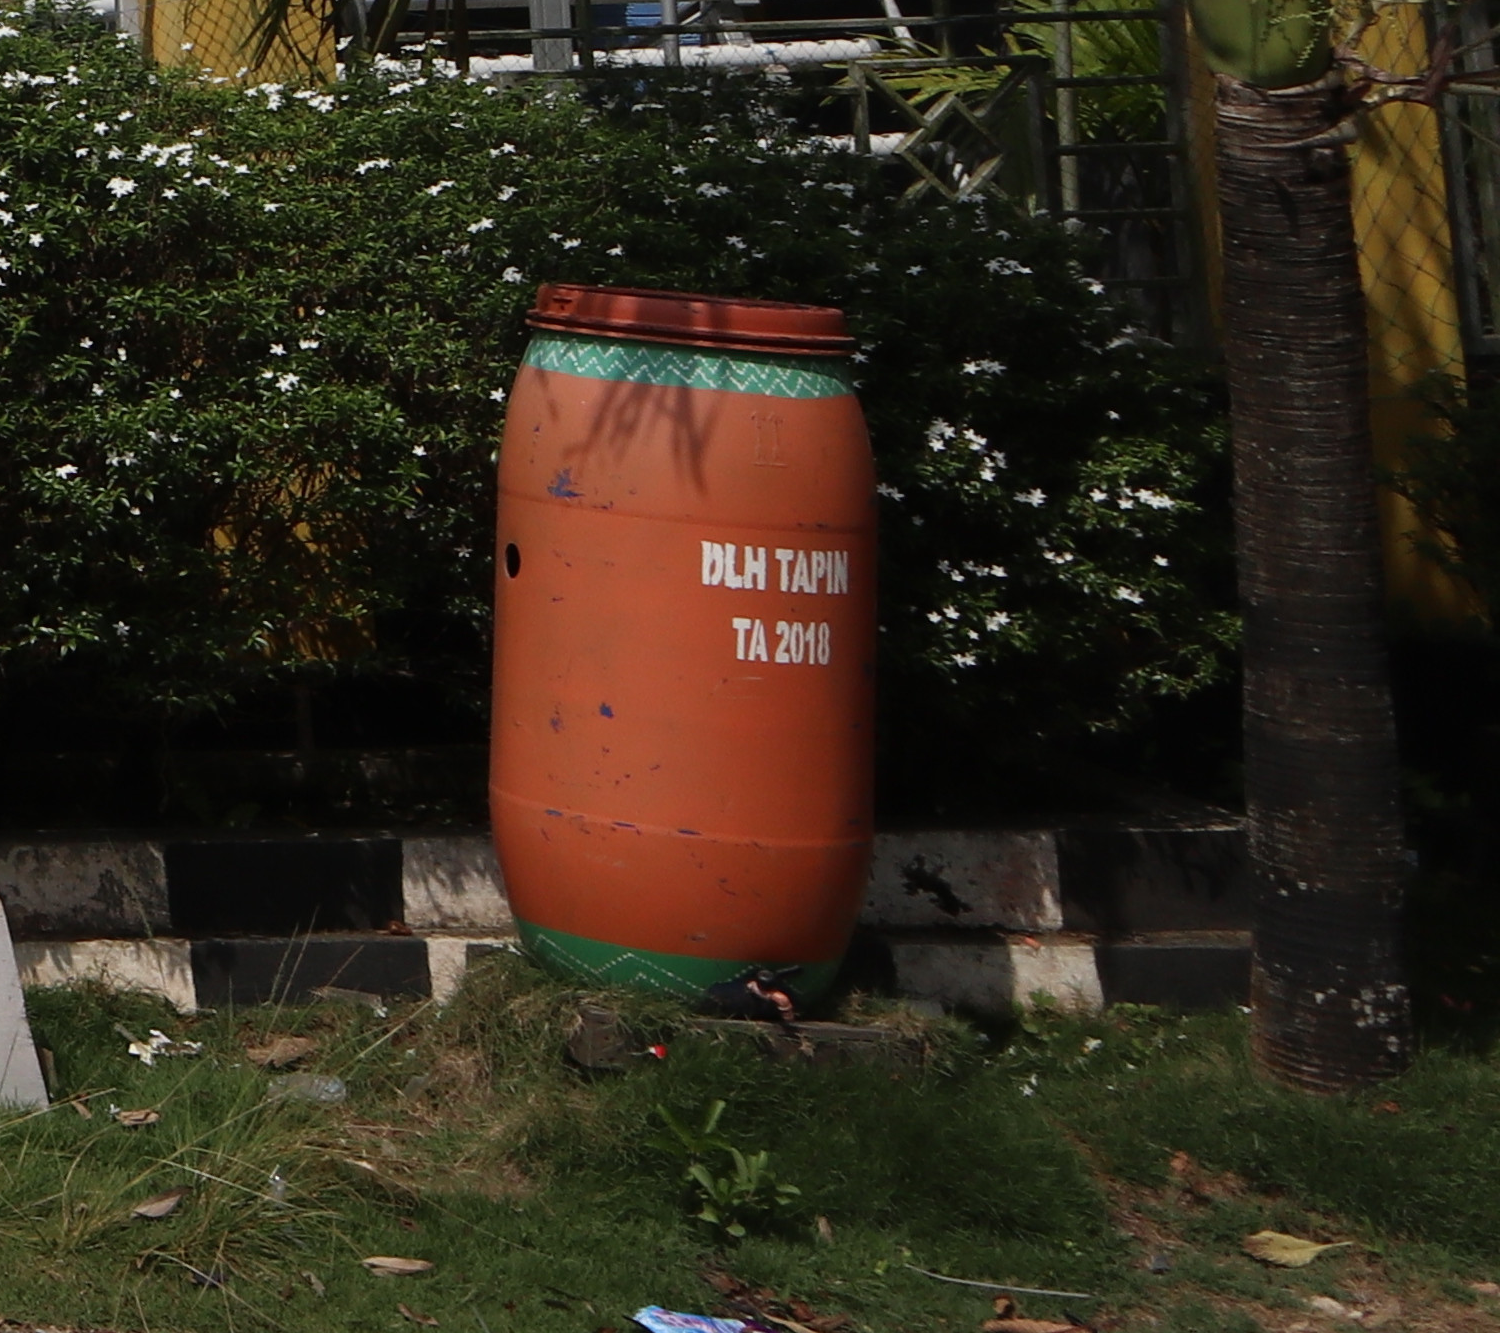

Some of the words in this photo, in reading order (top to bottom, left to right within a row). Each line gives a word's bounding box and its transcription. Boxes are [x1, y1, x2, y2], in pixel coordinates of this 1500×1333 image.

[701, 540, 767, 591] DLH
[774, 548, 849, 595] TAPIN
[732, 617, 768, 662] TA
[774, 621, 830, 665] 2018
